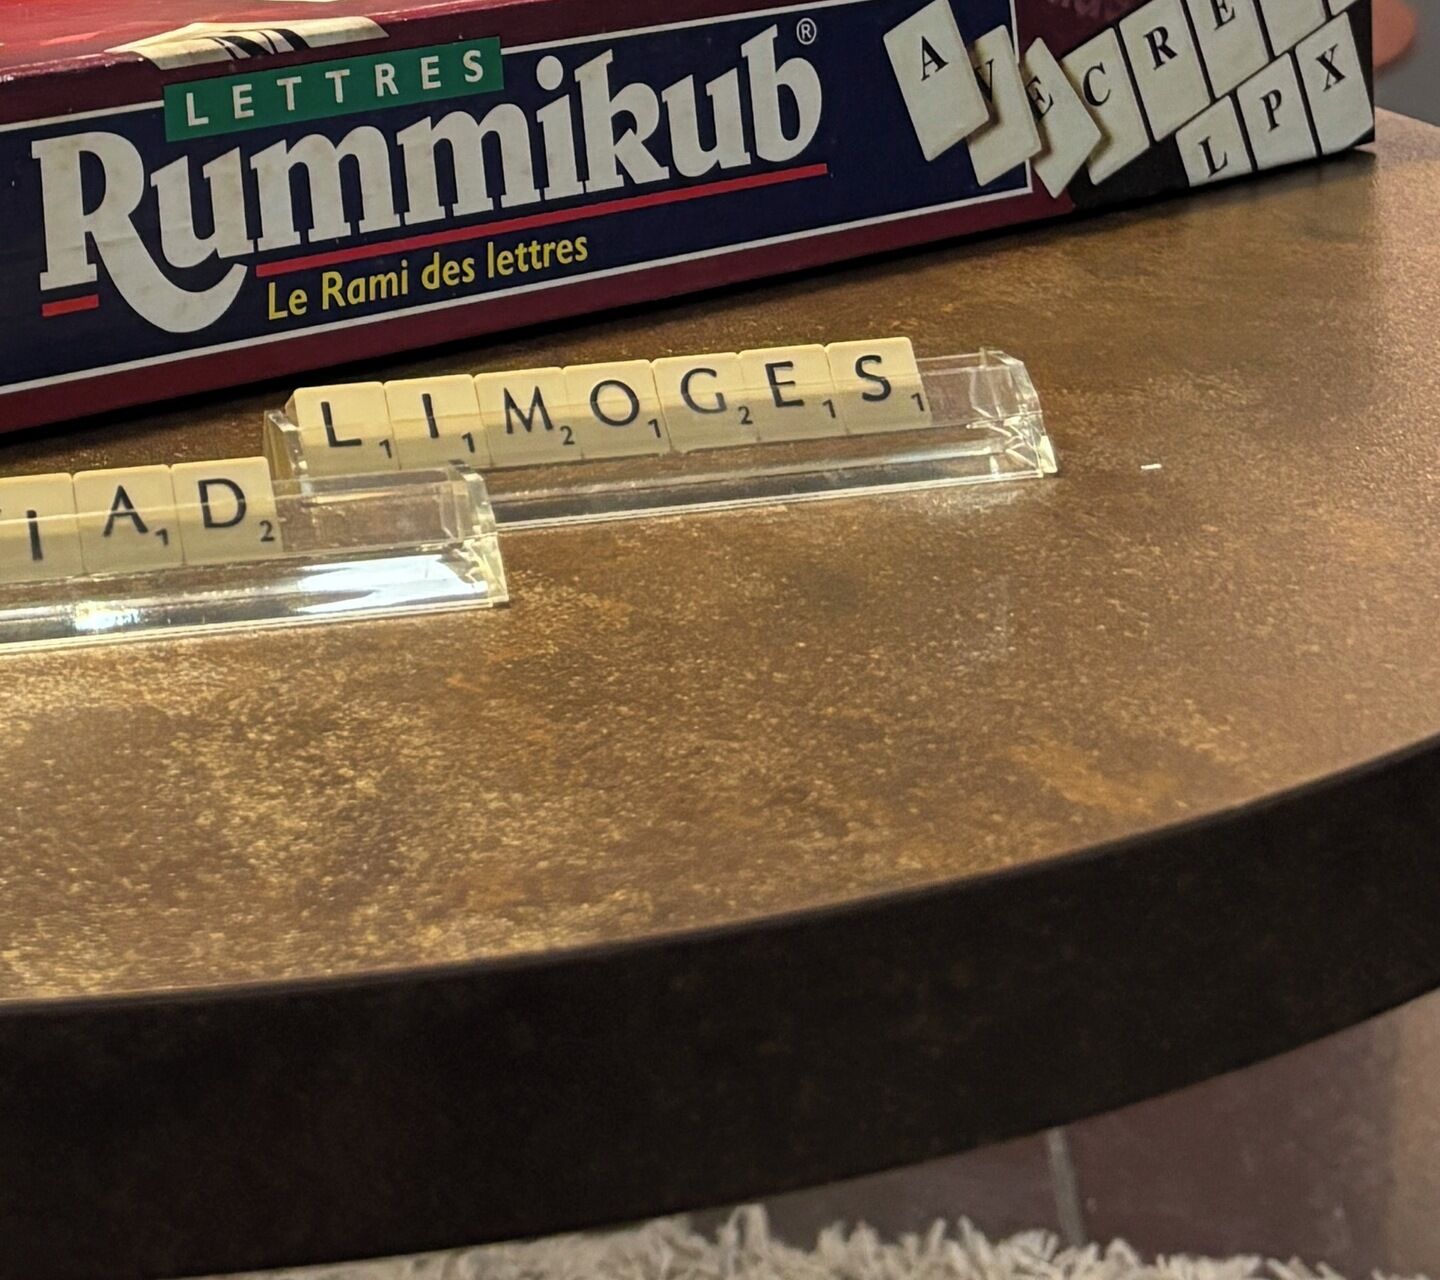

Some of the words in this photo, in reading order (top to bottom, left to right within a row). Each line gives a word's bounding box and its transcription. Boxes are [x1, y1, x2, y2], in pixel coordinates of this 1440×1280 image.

[185, 47, 489, 127] LETTRES
[32, 23, 822, 333] Rummikub
[268, 281, 309, 321] Le
[321, 263, 409, 312] Rami
[422, 252, 474, 291] des
[487, 232, 589, 276] lettres
